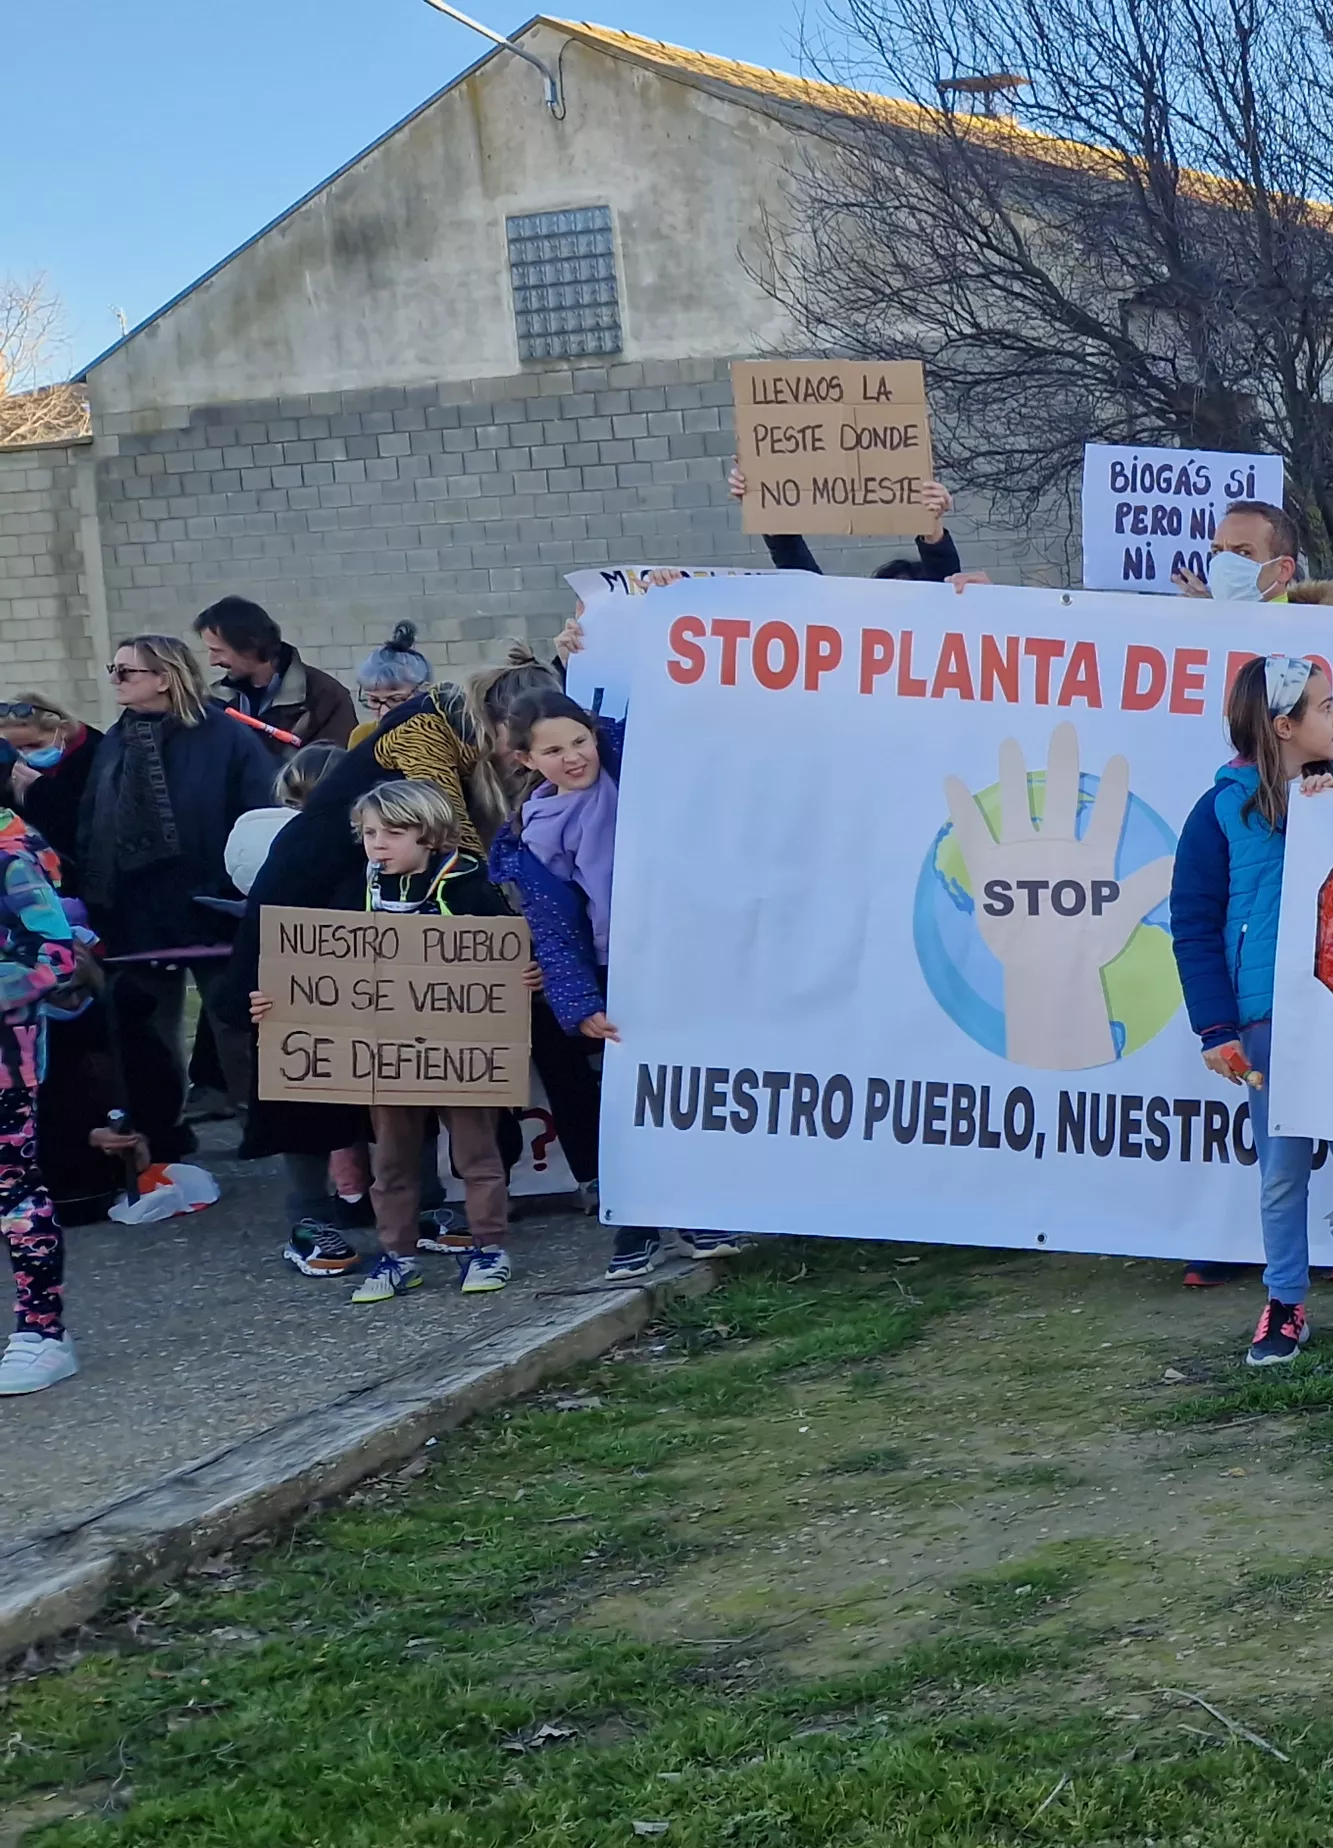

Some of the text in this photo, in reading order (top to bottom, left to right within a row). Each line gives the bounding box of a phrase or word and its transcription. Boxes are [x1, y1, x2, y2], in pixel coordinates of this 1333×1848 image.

[752, 375, 892, 404] LLEVAOS LA
[753, 424, 919, 456] PESTE DONDE
[761, 477, 922, 508] NO MOLESTE
[1110, 455, 1212, 496] BIOGÁS
[1115, 502, 1217, 540] PERO NI
[1123, 541, 1156, 581] NI
[667, 615, 843, 692] STOP
[859, 627, 1103, 708] PLANTA
[1120, 644, 1208, 716] DE
[982, 879, 1120, 917] STOP
[279, 922, 521, 963] NUESTRO PUEBLO
[290, 975, 507, 1014] NO SE VENDE
[279, 1031, 510, 1083] SE DEFIENDE
[634, 1063, 853, 1140] NUESTRO
[863, 1077, 1046, 1159] PUEBLO,
[1057, 1090, 1258, 1166] NUESTRO
